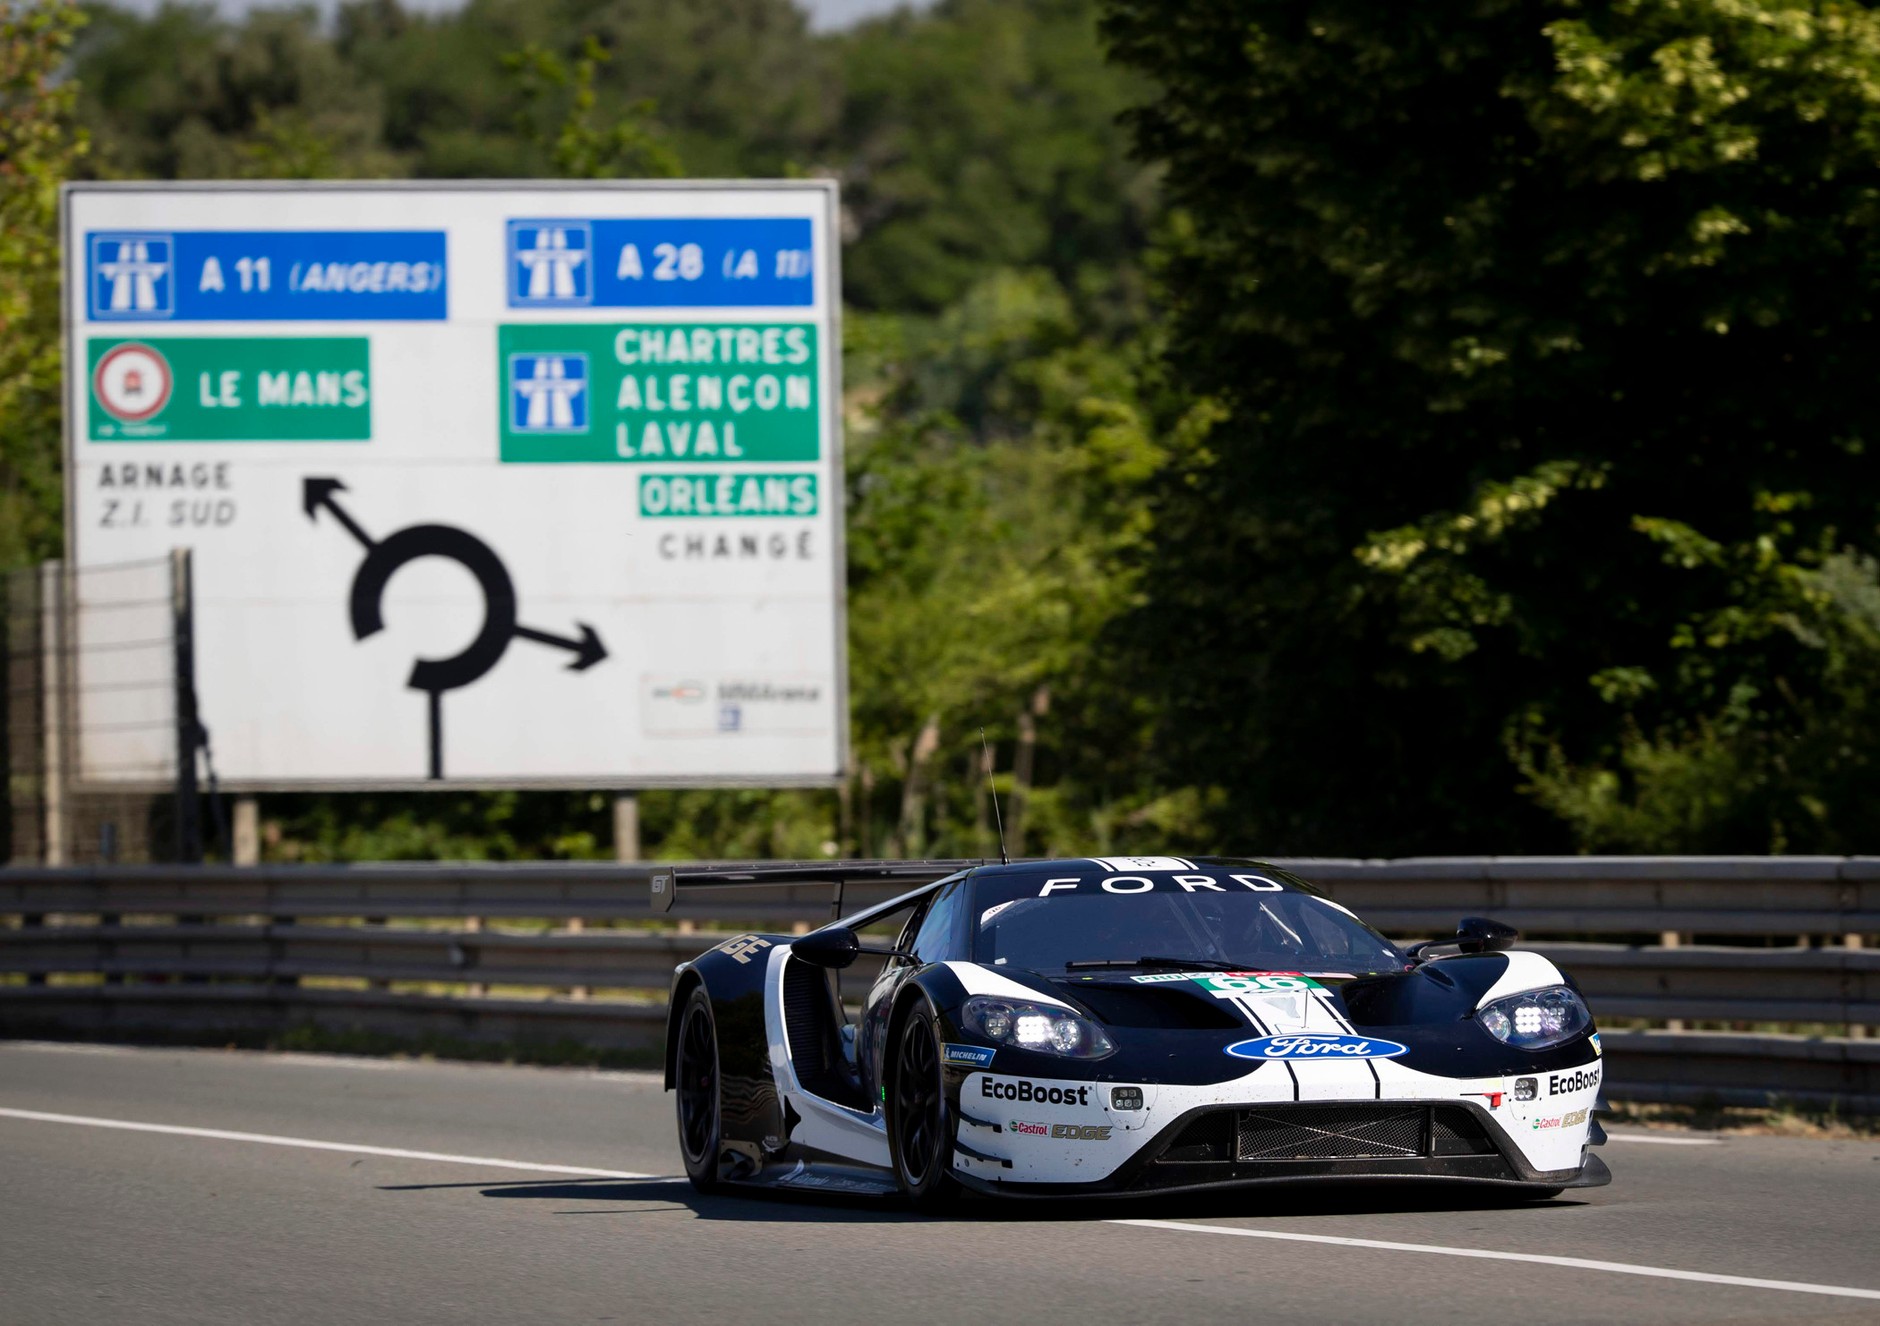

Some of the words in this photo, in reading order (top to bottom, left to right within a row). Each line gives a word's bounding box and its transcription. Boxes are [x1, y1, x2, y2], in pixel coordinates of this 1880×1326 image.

[200, 257, 224, 292] A
[234, 257, 271, 292] 11
[289, 261, 443, 294] (ANGERS)
[617, 243, 643, 280] A
[652, 243, 704, 280] 28
[723, 249, 759, 279] (A
[614, 328, 810, 364] CHARTRES
[200, 371, 241, 407] LE
[258, 371, 368, 407] MANS
[617, 374, 811, 414] ALENÇON
[616, 421, 743, 457] LAVAL
[98, 462, 231, 489] ARNAGE
[643, 475, 816, 514] ORLÉANS
[168, 499, 237, 527] SUD
[658, 529, 813, 560] CHANGÉ
[1038, 874, 1284, 897] FORD
[1208, 975, 1308, 991] 66
[950, 1051, 987, 1061] MICHELIN
[1264, 1036, 1371, 1056] Ford
[982, 1076, 1088, 1106] EcoBoost
[1549, 1068, 1600, 1096] EcoBoost
[1018, 1122, 1048, 1135] Castrol
[1051, 1124, 1113, 1140] EDGE
[1540, 1117, 1560, 1129] Castrol
